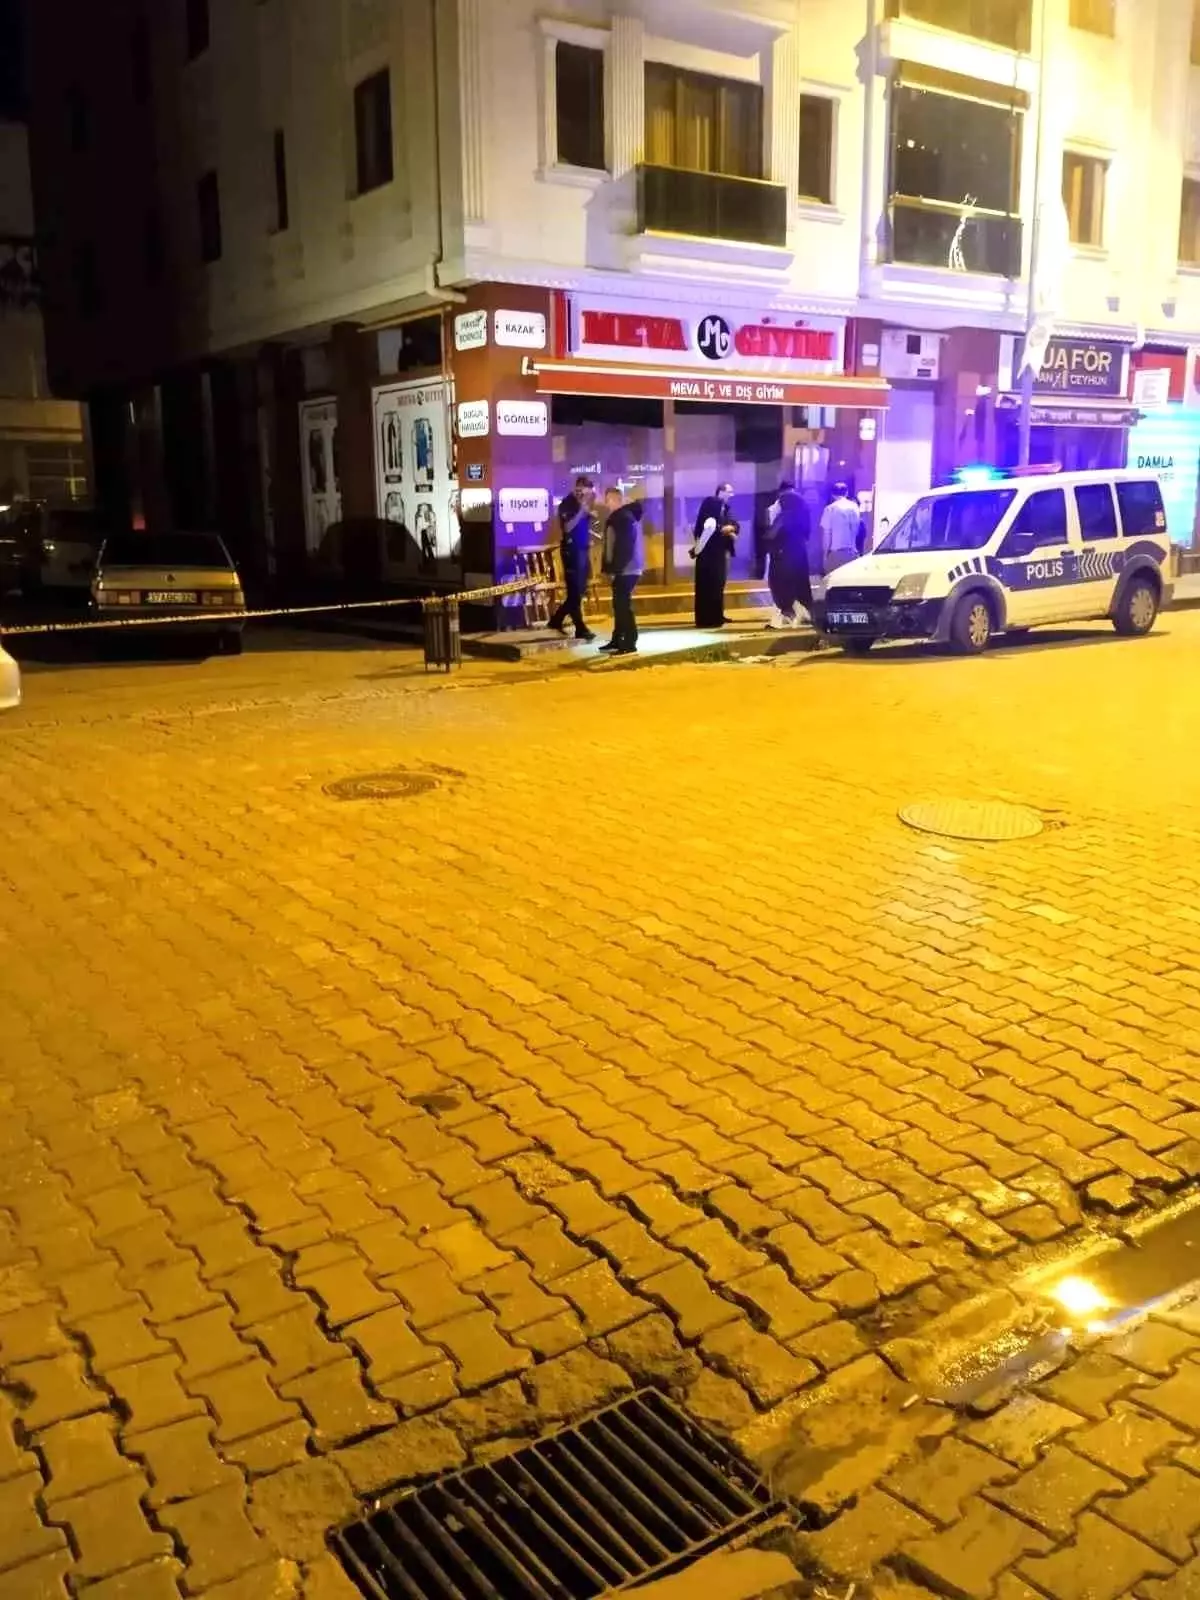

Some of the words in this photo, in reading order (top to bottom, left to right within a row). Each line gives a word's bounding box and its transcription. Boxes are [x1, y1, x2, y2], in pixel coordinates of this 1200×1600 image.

[505, 323, 534, 334] KAZAK
[1040, 345, 1112, 373] UAFÖR
[1070, 375, 1107, 385] CEYHUN
[670, 382, 700, 395] MEVA
[704, 382, 715, 398] İÇ
[719, 385, 732, 396] VE
[756, 385, 785, 399] GİYİM
[1137, 455, 1174, 469] DAMLA
